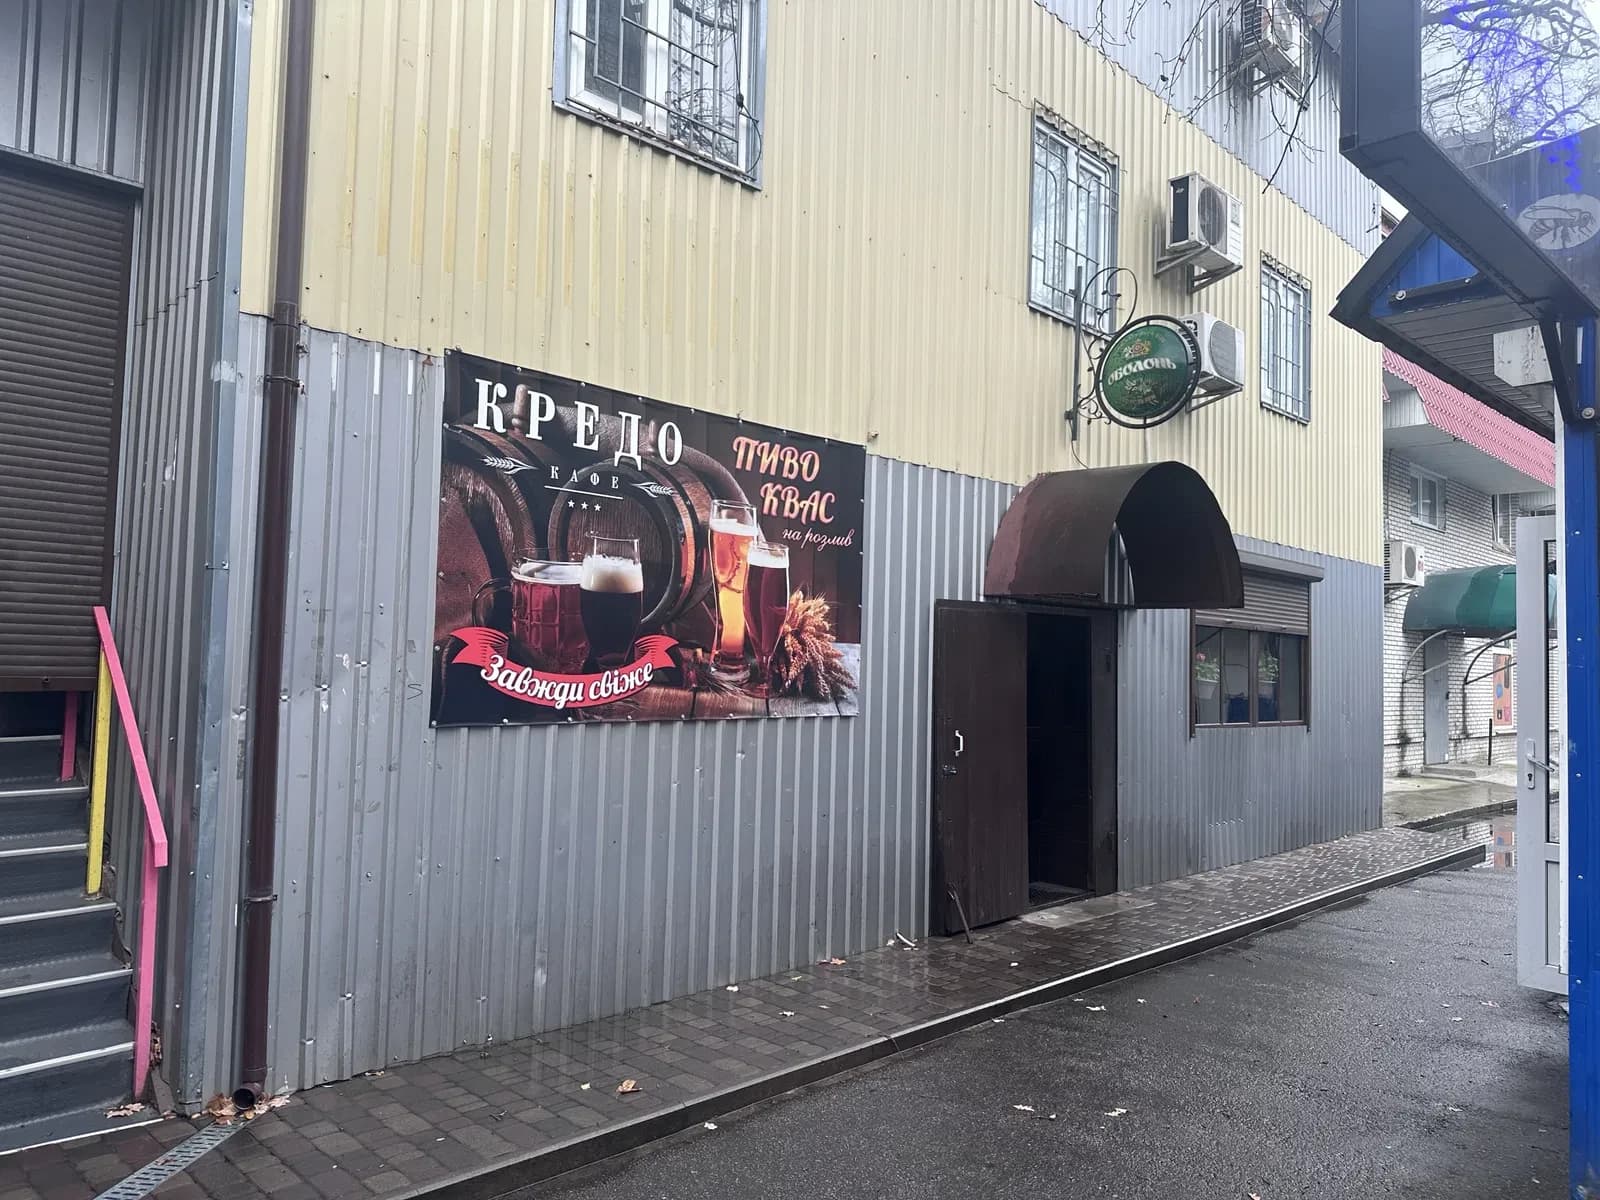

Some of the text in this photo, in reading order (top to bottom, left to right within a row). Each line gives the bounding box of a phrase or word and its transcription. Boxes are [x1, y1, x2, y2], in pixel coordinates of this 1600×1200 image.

[1108, 357, 1176, 385] ОБОЛОНЬ
[473, 378, 683, 471] КРЕДО
[550, 465, 619, 489] КАФЕ
[732, 436, 820, 482] ПИВО
[760, 482, 836, 525] КВАС
[782, 528, 855, 552] на розлив
[480, 654, 653, 709] Завжди свіже
